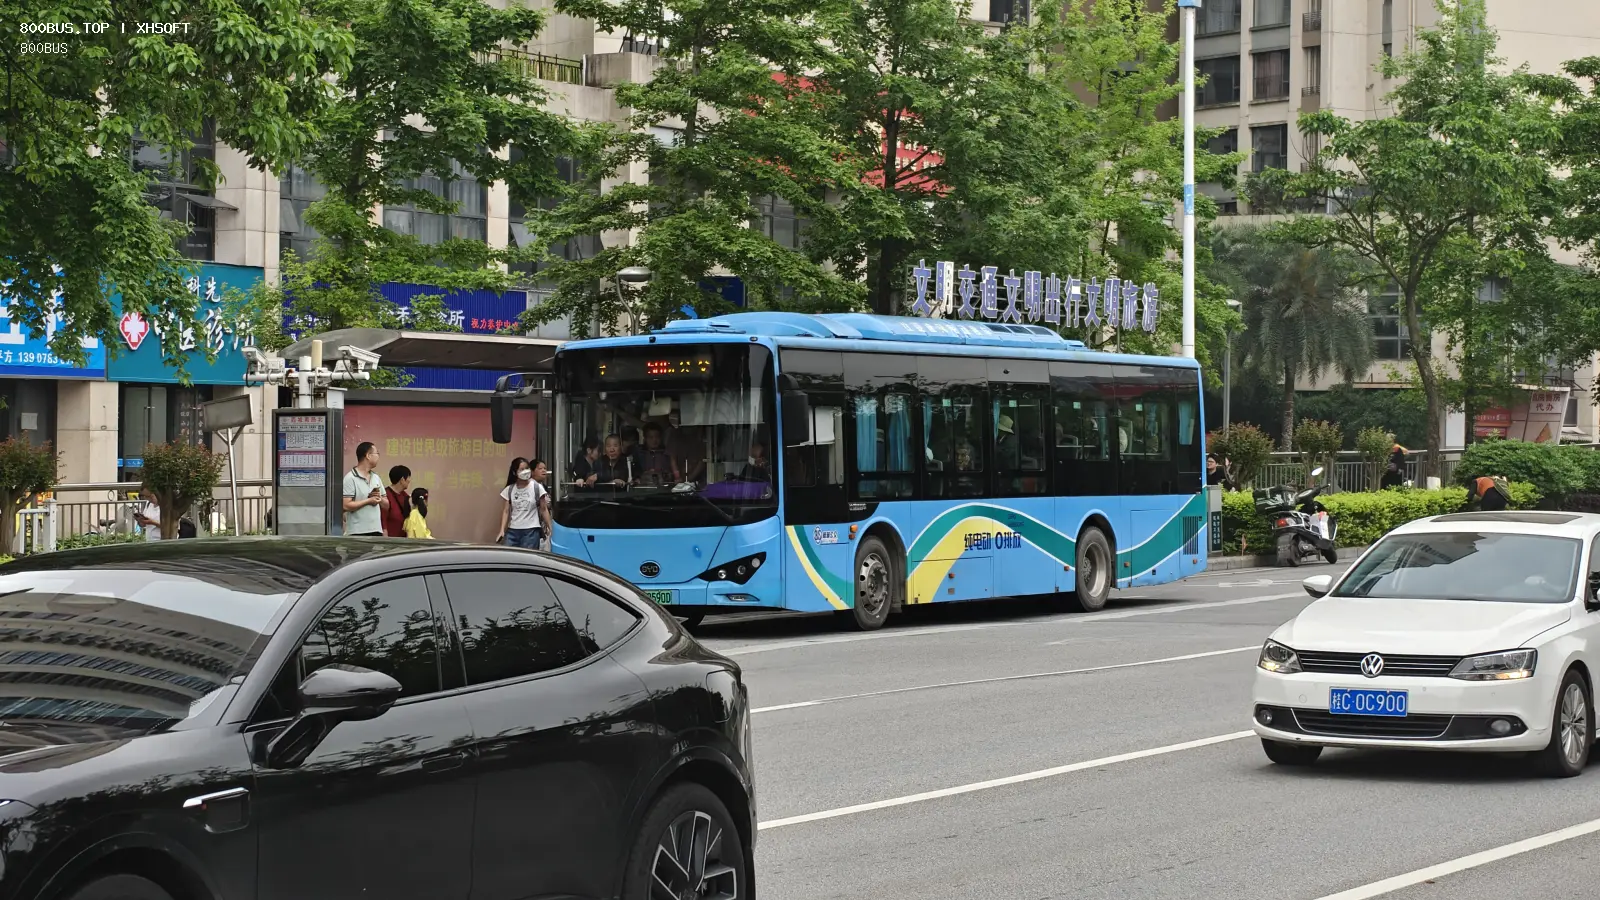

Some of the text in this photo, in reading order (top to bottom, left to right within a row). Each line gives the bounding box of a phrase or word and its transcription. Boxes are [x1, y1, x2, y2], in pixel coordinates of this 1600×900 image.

[912, 258, 1160, 334] 文明交通文明出行文明旅游
[18, 352, 35, 363] 139
